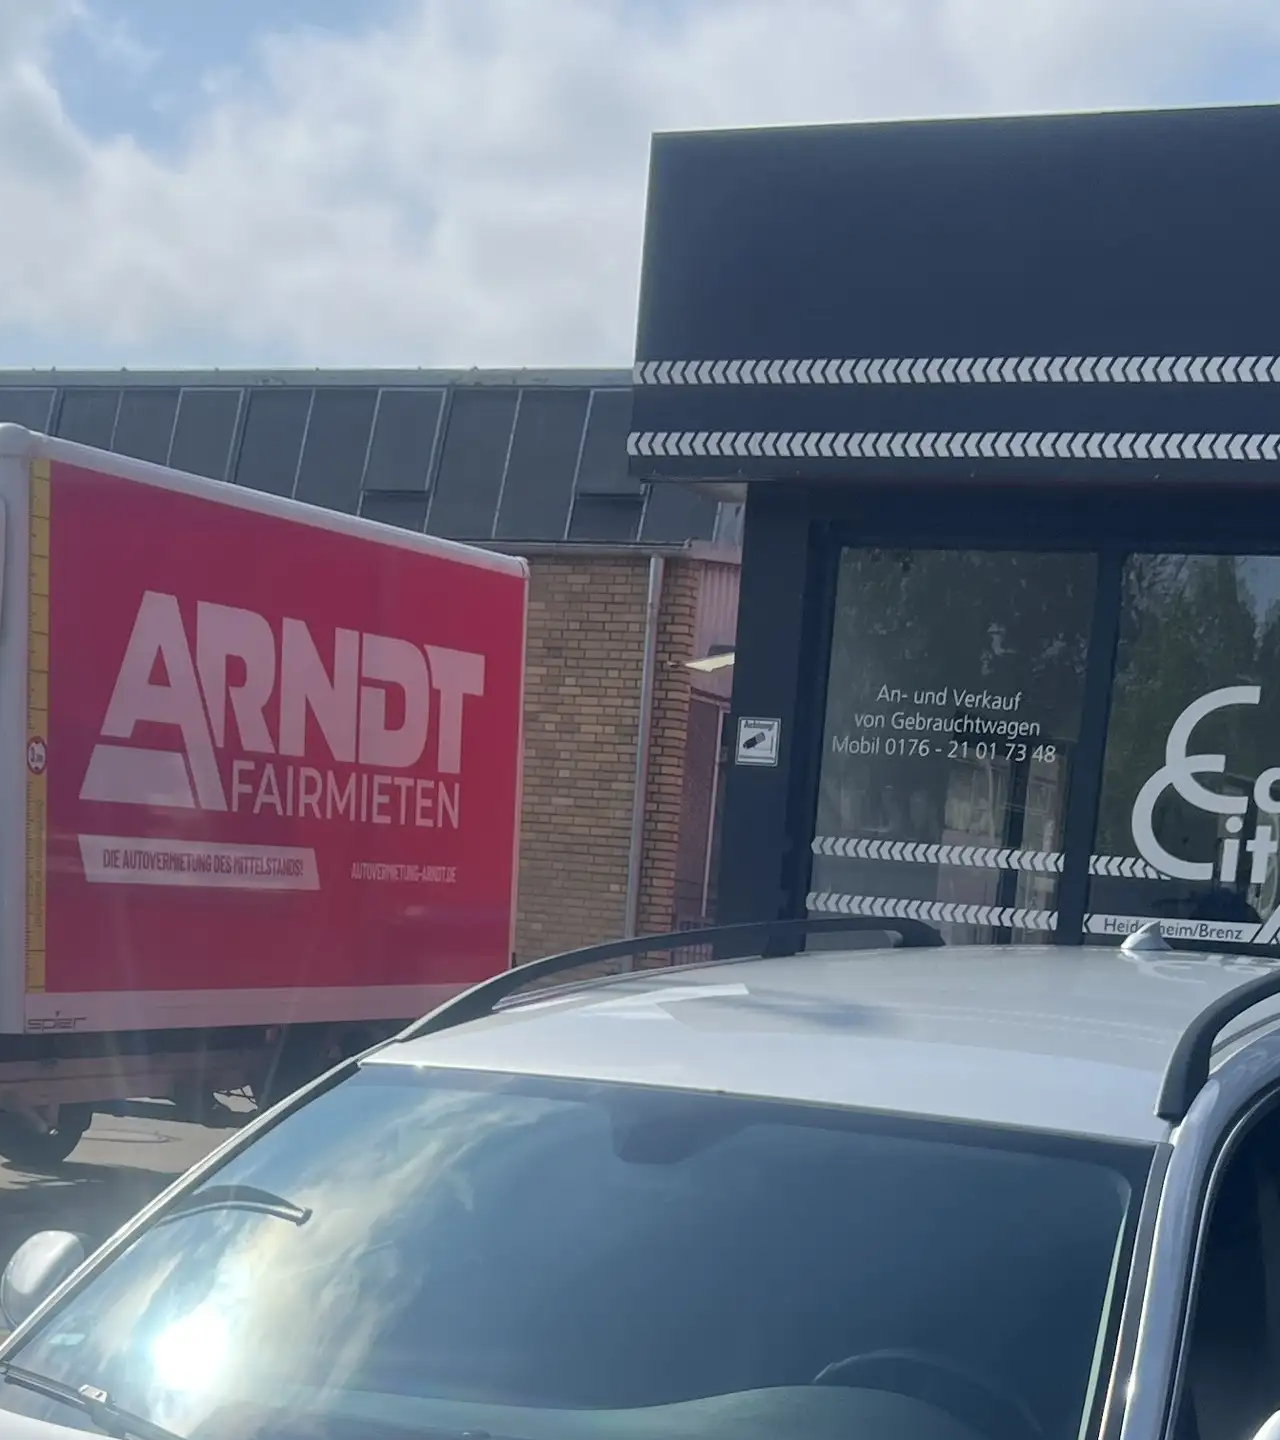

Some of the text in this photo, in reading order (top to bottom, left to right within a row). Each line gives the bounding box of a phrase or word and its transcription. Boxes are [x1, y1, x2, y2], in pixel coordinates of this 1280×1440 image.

[97, 590, 485, 811] ARNDT
[875, 684, 1023, 711] An- und Verkauf
[854, 711, 1041, 739] von Gebrauchtwagen
[831, 735, 880, 755] Mobil
[885, 738, 930, 757] 0176
[947, 740, 968, 759] 21
[975, 742, 996, 760] 01
[1005, 743, 1027, 762] 73
[1031, 744, 1057, 763] 48
[231, 759, 461, 830] FAIRMIETEN
[102, 848, 120, 870] DIE
[213, 855, 232, 875] DES
